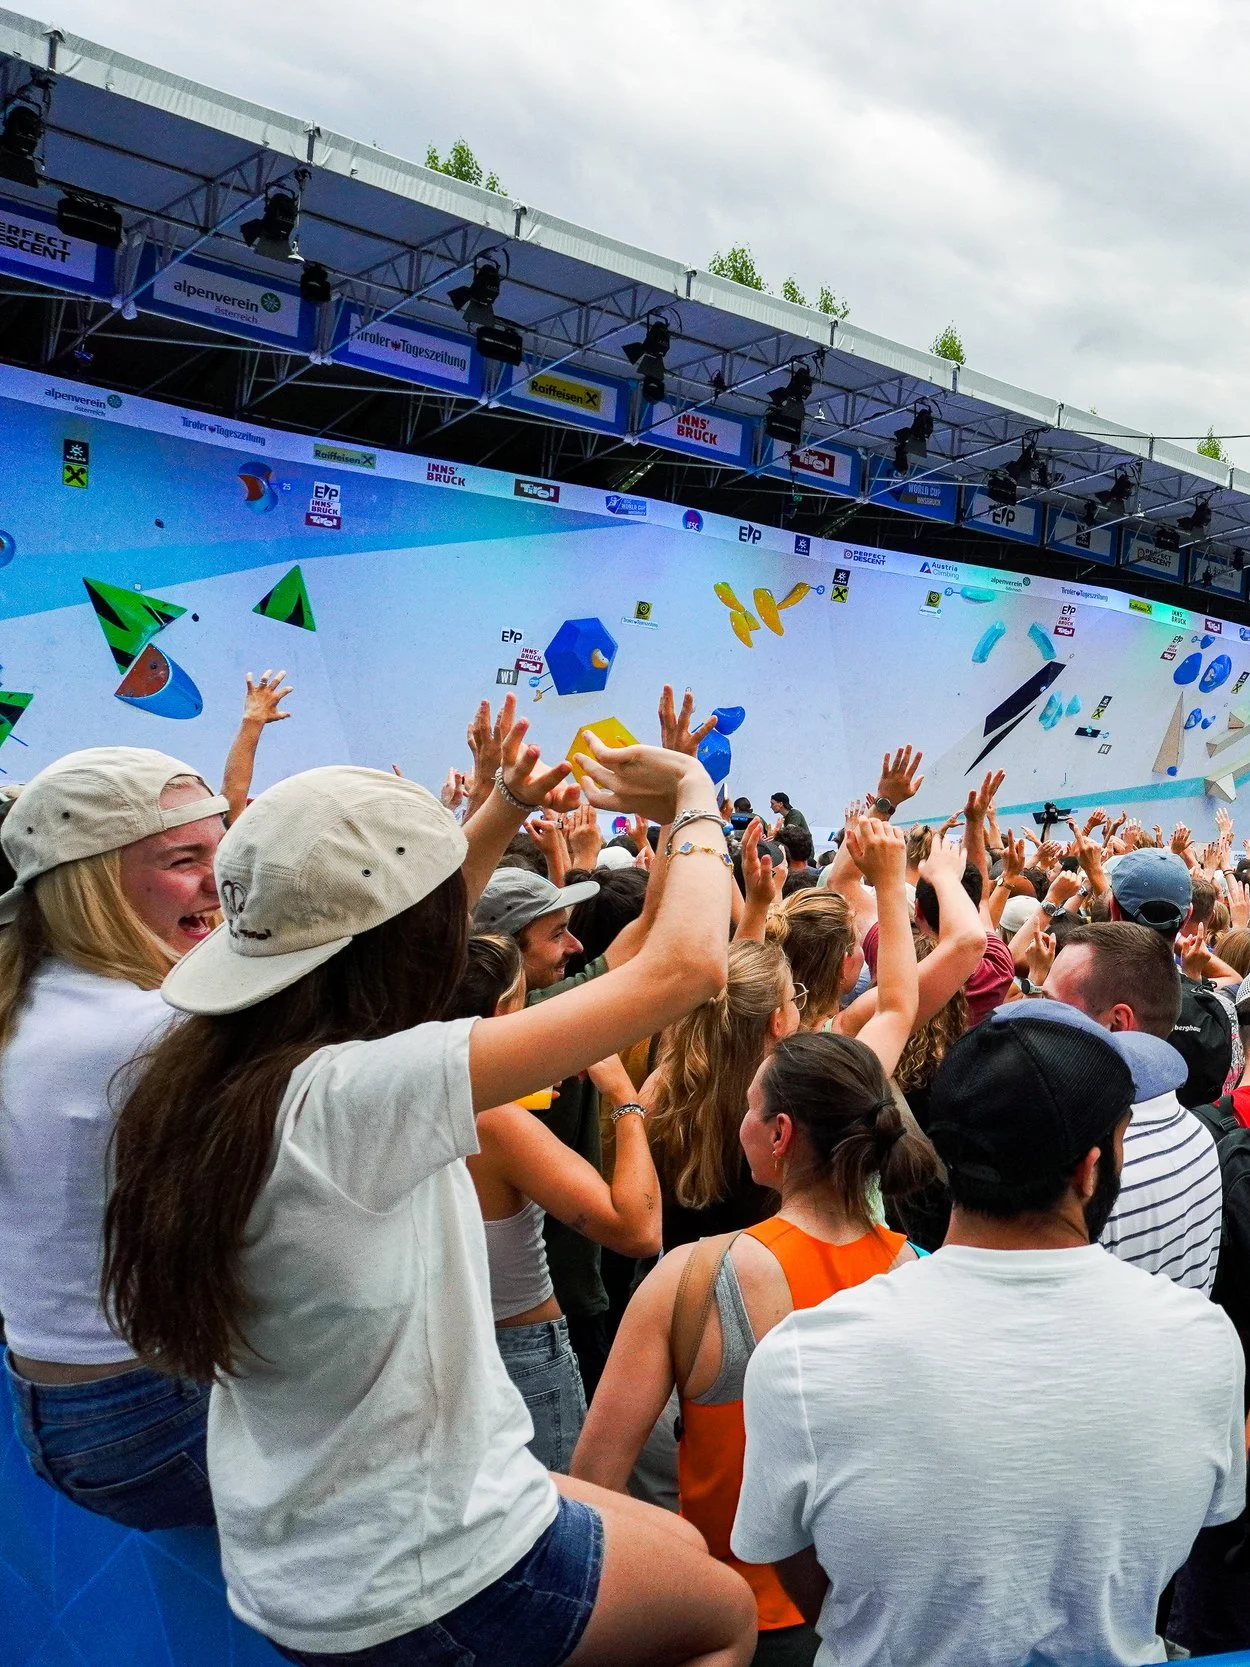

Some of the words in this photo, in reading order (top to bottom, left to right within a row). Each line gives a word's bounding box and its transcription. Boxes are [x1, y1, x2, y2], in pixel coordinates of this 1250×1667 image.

[174, 280, 258, 313] alpenverein
[215, 306, 258, 324] österreich
[400, 339, 467, 371] Tageszeitung
[45, 388, 106, 409] alpenverein
[531, 380, 583, 404] Raiffeisen
[181, 416, 208, 432] Tiroler
[214, 425, 266, 446] Tageszeitung
[677, 425, 718, 445] BRUCK
[315, 449, 361, 465] Raiffeisen
[427, 462, 459, 475] INNS'
[282, 482, 291, 491] 25
[427, 472, 465, 487] BRUCK
[520, 482, 555, 498] Tirol
[908, 482, 928, 496] WORLD
[930, 486, 941, 497] CUP
[311, 505, 338, 515] BRUCK
[687, 521, 699, 531] IFSC
[853, 550, 886, 560] PERFECT
[853, 555, 886, 566] DESCENT
[932, 562, 958, 572] Austria
[933, 569, 960, 581] Climbing
[991, 577, 1023, 588] alpenverein
[521, 653, 542, 661] BRUCK
[501, 671, 514, 683] W1
